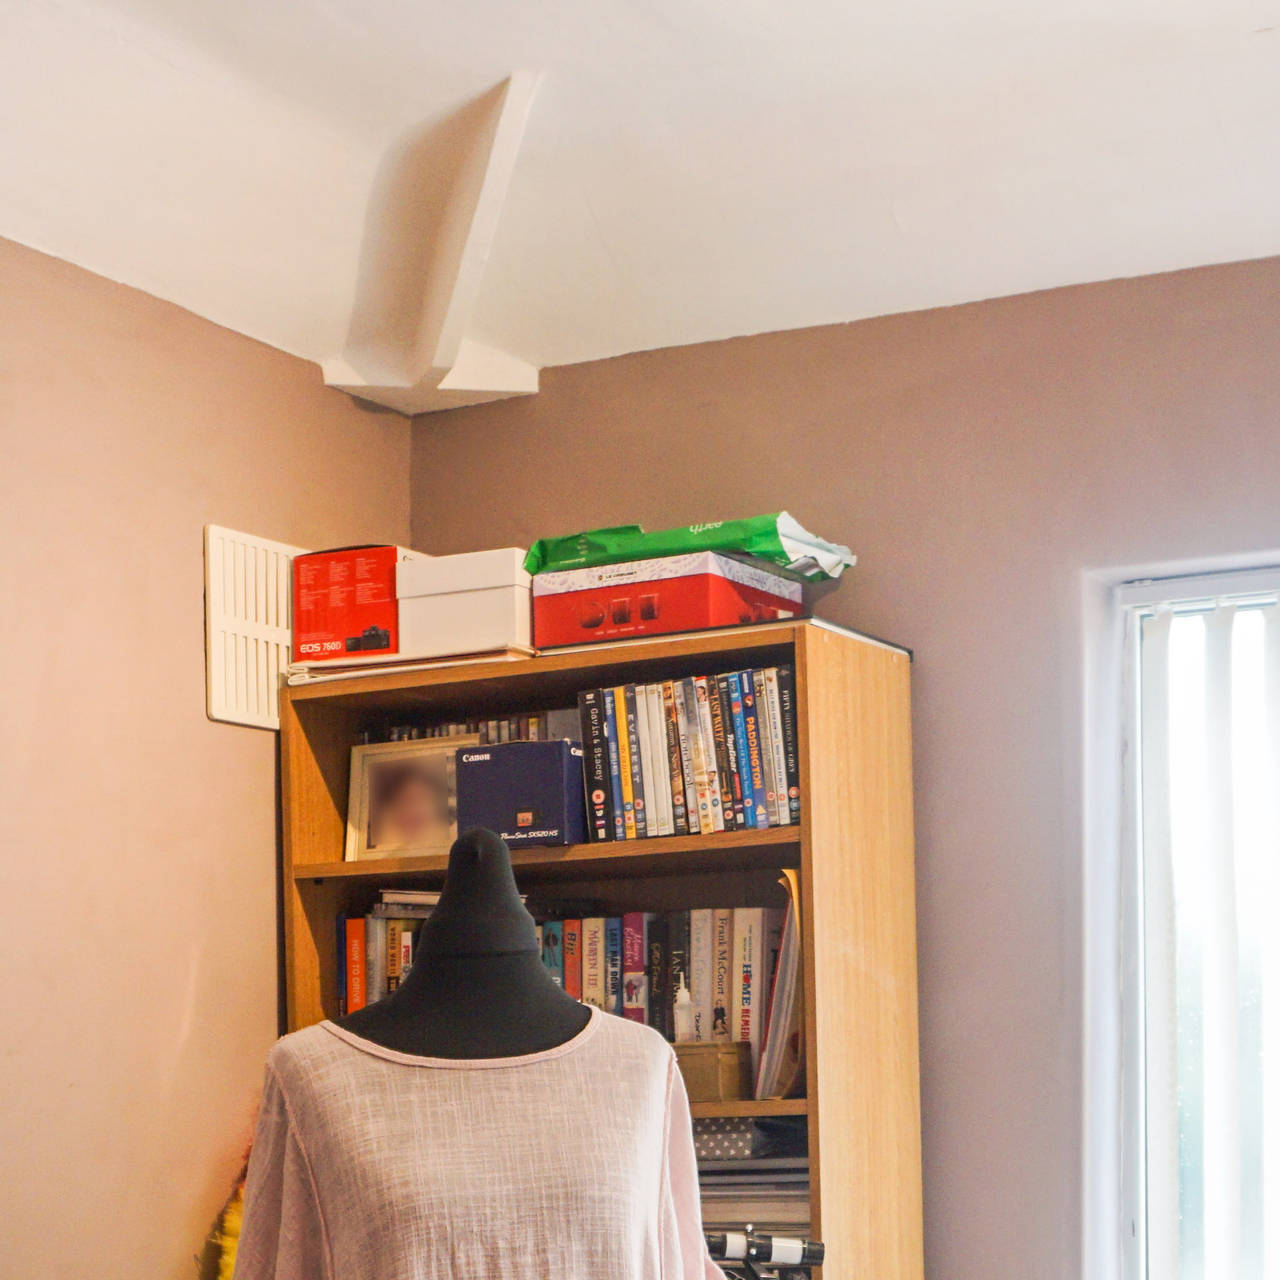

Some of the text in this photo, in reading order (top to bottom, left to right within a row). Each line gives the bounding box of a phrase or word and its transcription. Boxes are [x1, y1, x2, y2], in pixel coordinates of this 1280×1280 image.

[300, 643, 321, 654] EOS
[590, 707, 600, 736] Gavin
[462, 753, 491, 763] Canon
[594, 747, 604, 781] Stacey
[628, 713, 640, 783] EVEREST
[746, 716, 762, 790] PADDINGTON
[351, 940, 361, 1004] HOW TO DRIVE
[716, 917, 729, 995] Frank McCourt
[610, 971, 618, 995] DOWN
[740, 1008, 751, 1041] REMEDI
